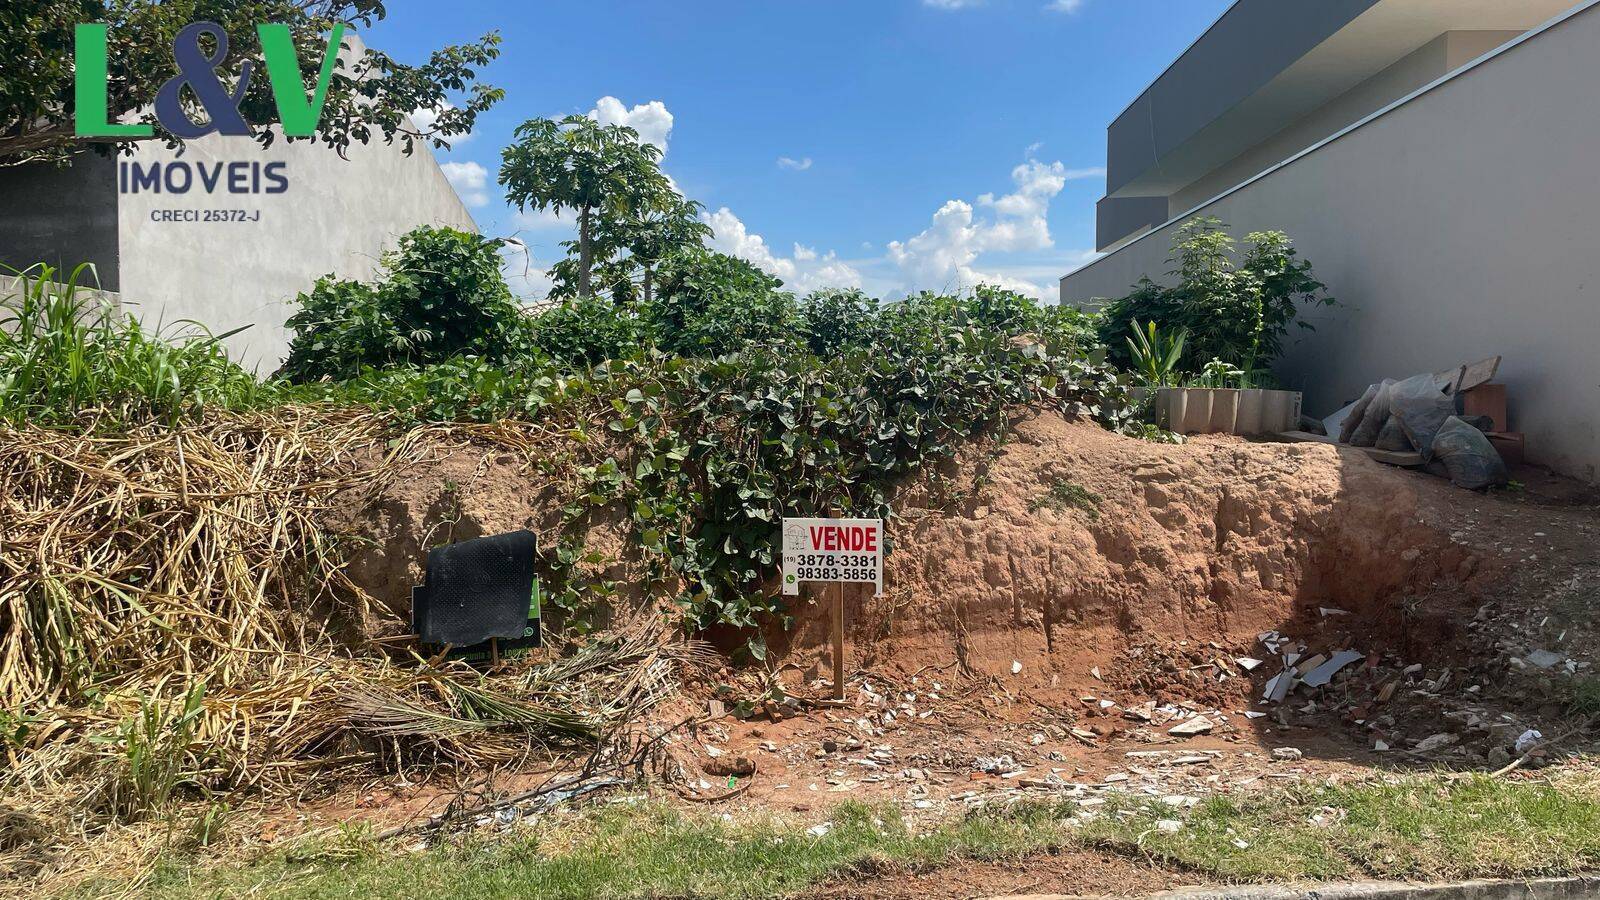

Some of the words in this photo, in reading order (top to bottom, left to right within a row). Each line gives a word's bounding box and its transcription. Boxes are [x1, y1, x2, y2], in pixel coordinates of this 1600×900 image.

[809, 526, 877, 551] VENDE
[797, 554, 877, 567] 3878-3381
[797, 567, 877, 580] 98383-5856
